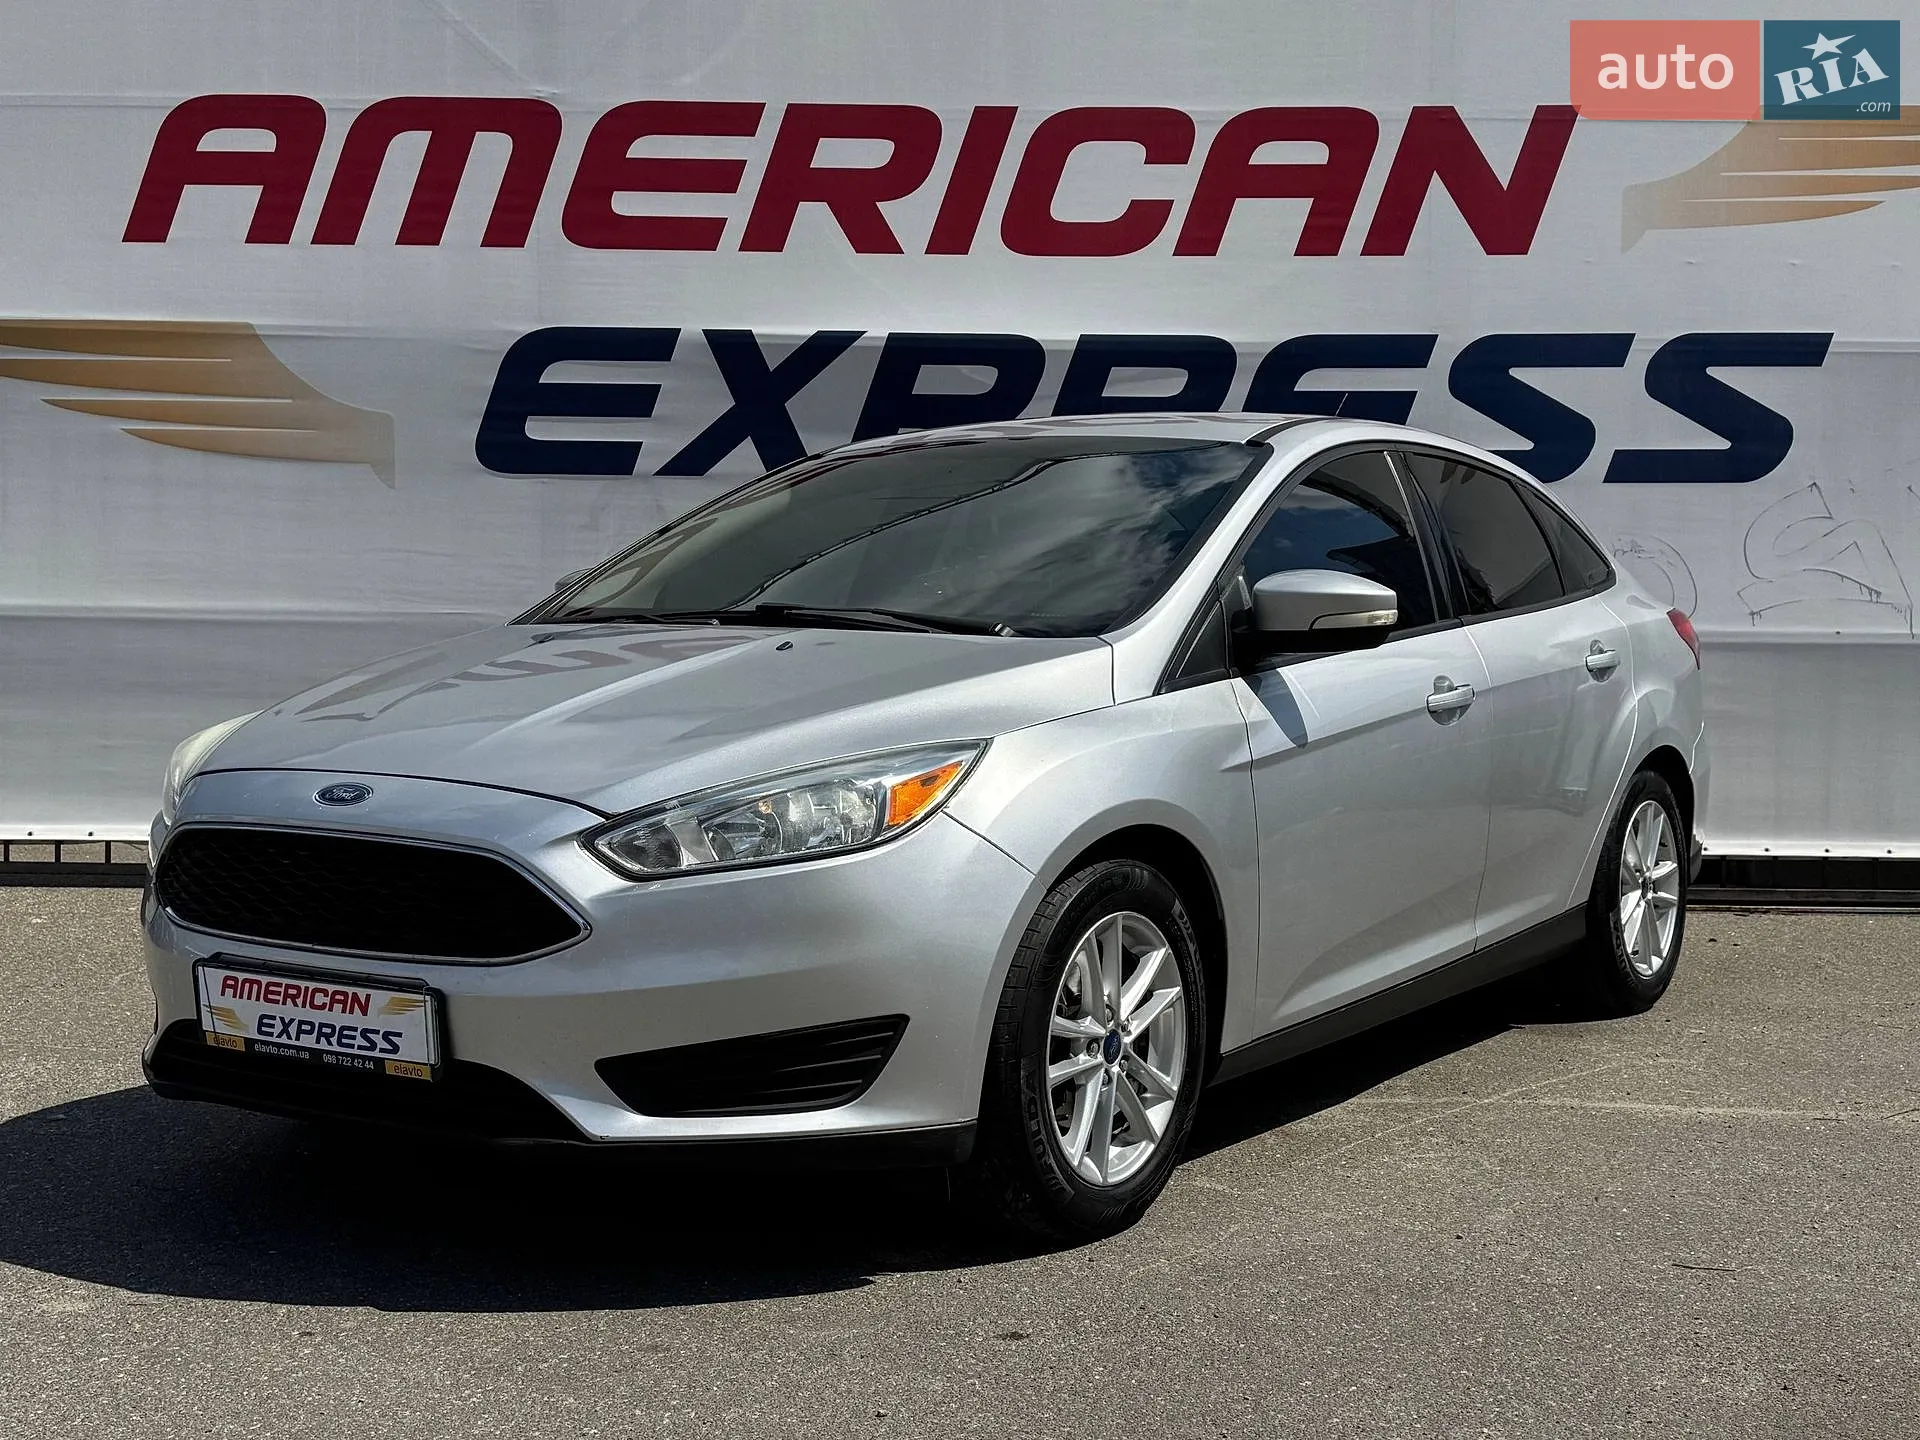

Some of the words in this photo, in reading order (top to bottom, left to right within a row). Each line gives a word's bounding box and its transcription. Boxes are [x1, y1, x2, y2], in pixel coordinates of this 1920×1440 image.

[121, 94, 1579, 257] AMERICAN
[220, 974, 372, 1017] AMERICAN
[256, 1013, 404, 1055] EXPRESS
[254, 1042, 310, 1060] elavto.com.ua
[338, 1055, 352, 1067] 722
[353, 1058, 364, 1068] 42
[364, 1060, 375, 1070] 44
[393, 1062, 424, 1078] elavto
